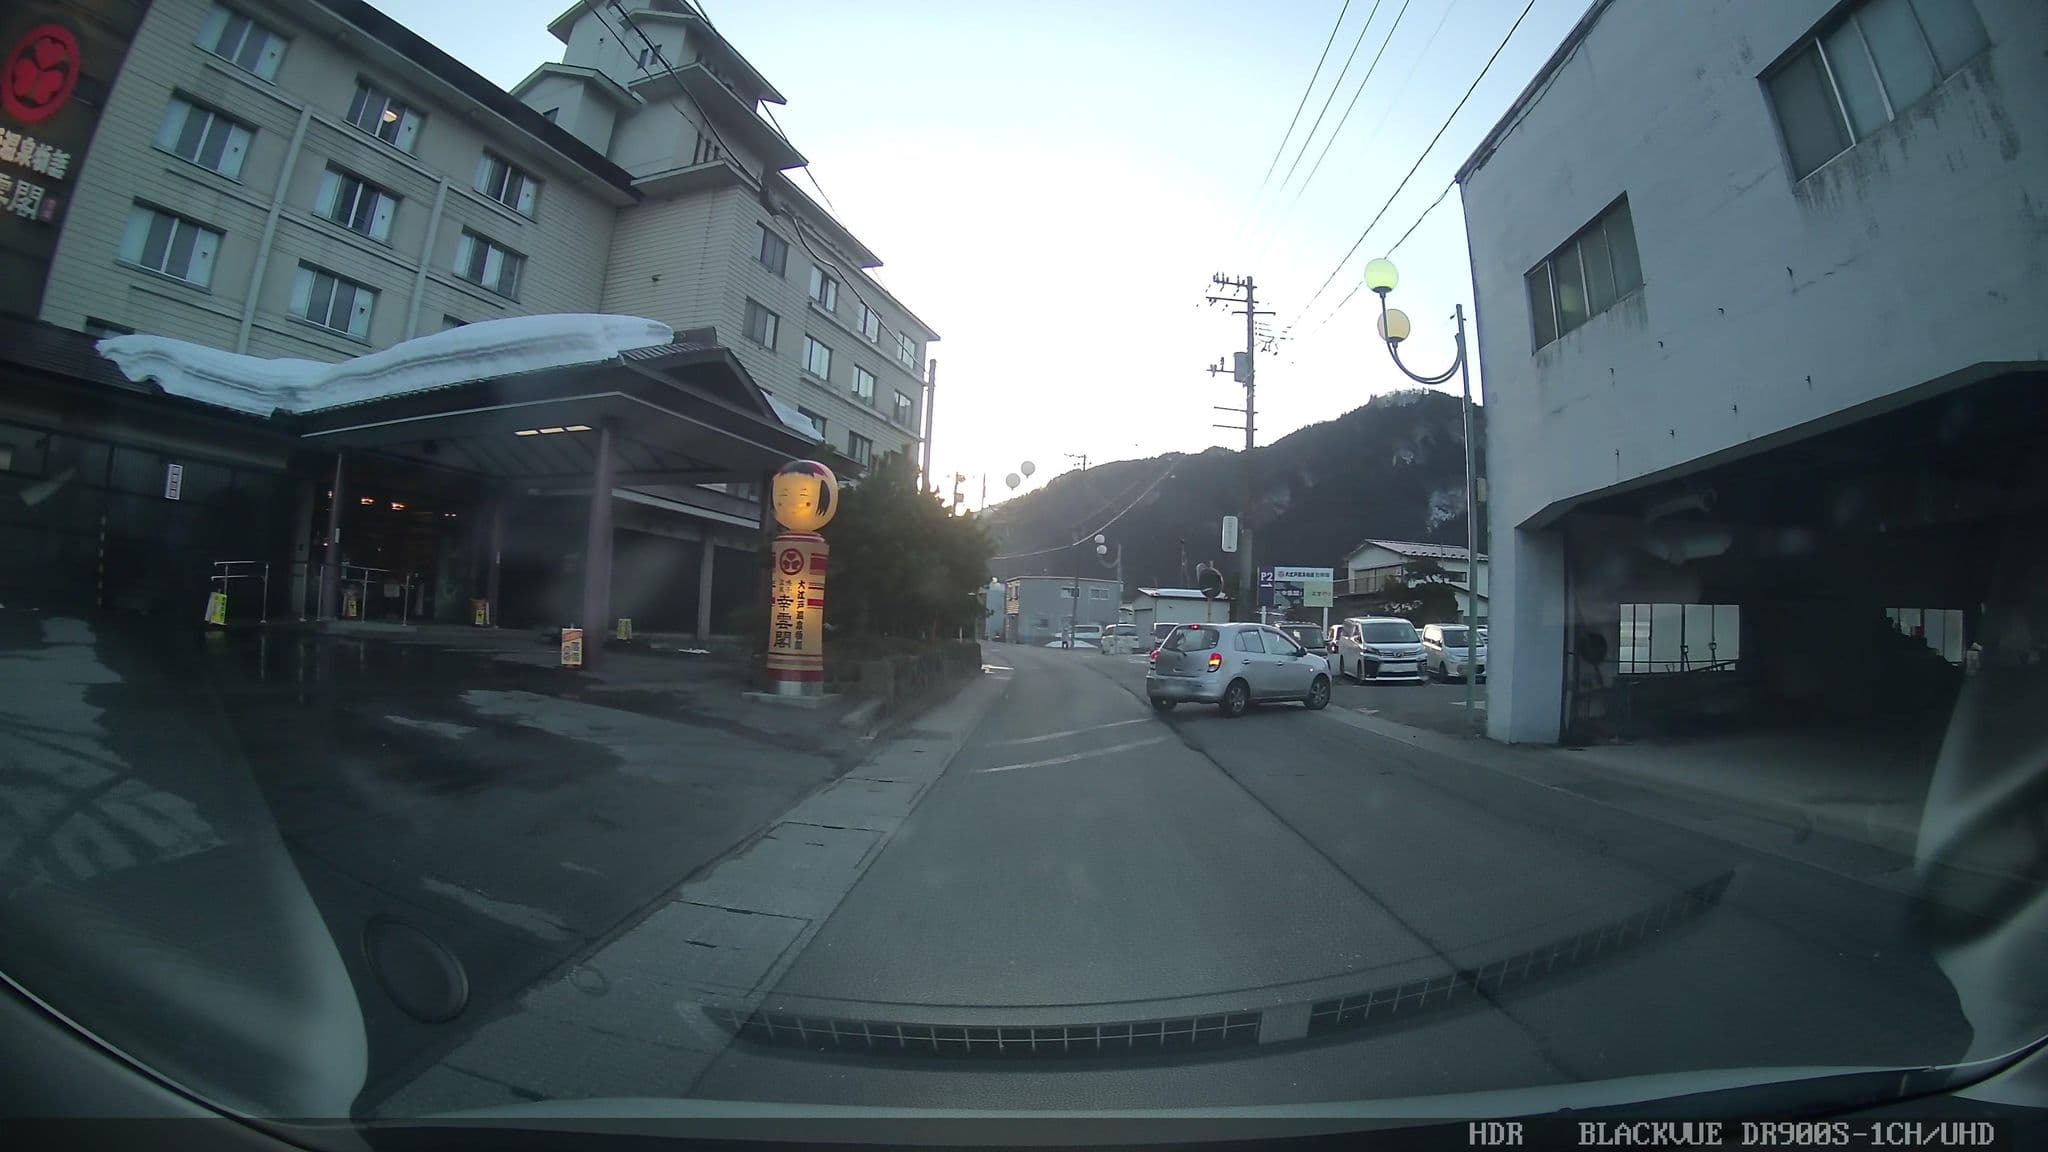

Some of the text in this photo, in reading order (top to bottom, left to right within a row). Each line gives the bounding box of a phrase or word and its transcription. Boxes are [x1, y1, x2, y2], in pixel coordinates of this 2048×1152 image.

[1260, 572, 1273, 582] P2
[774, 594, 794, 648] 幸雲閣
